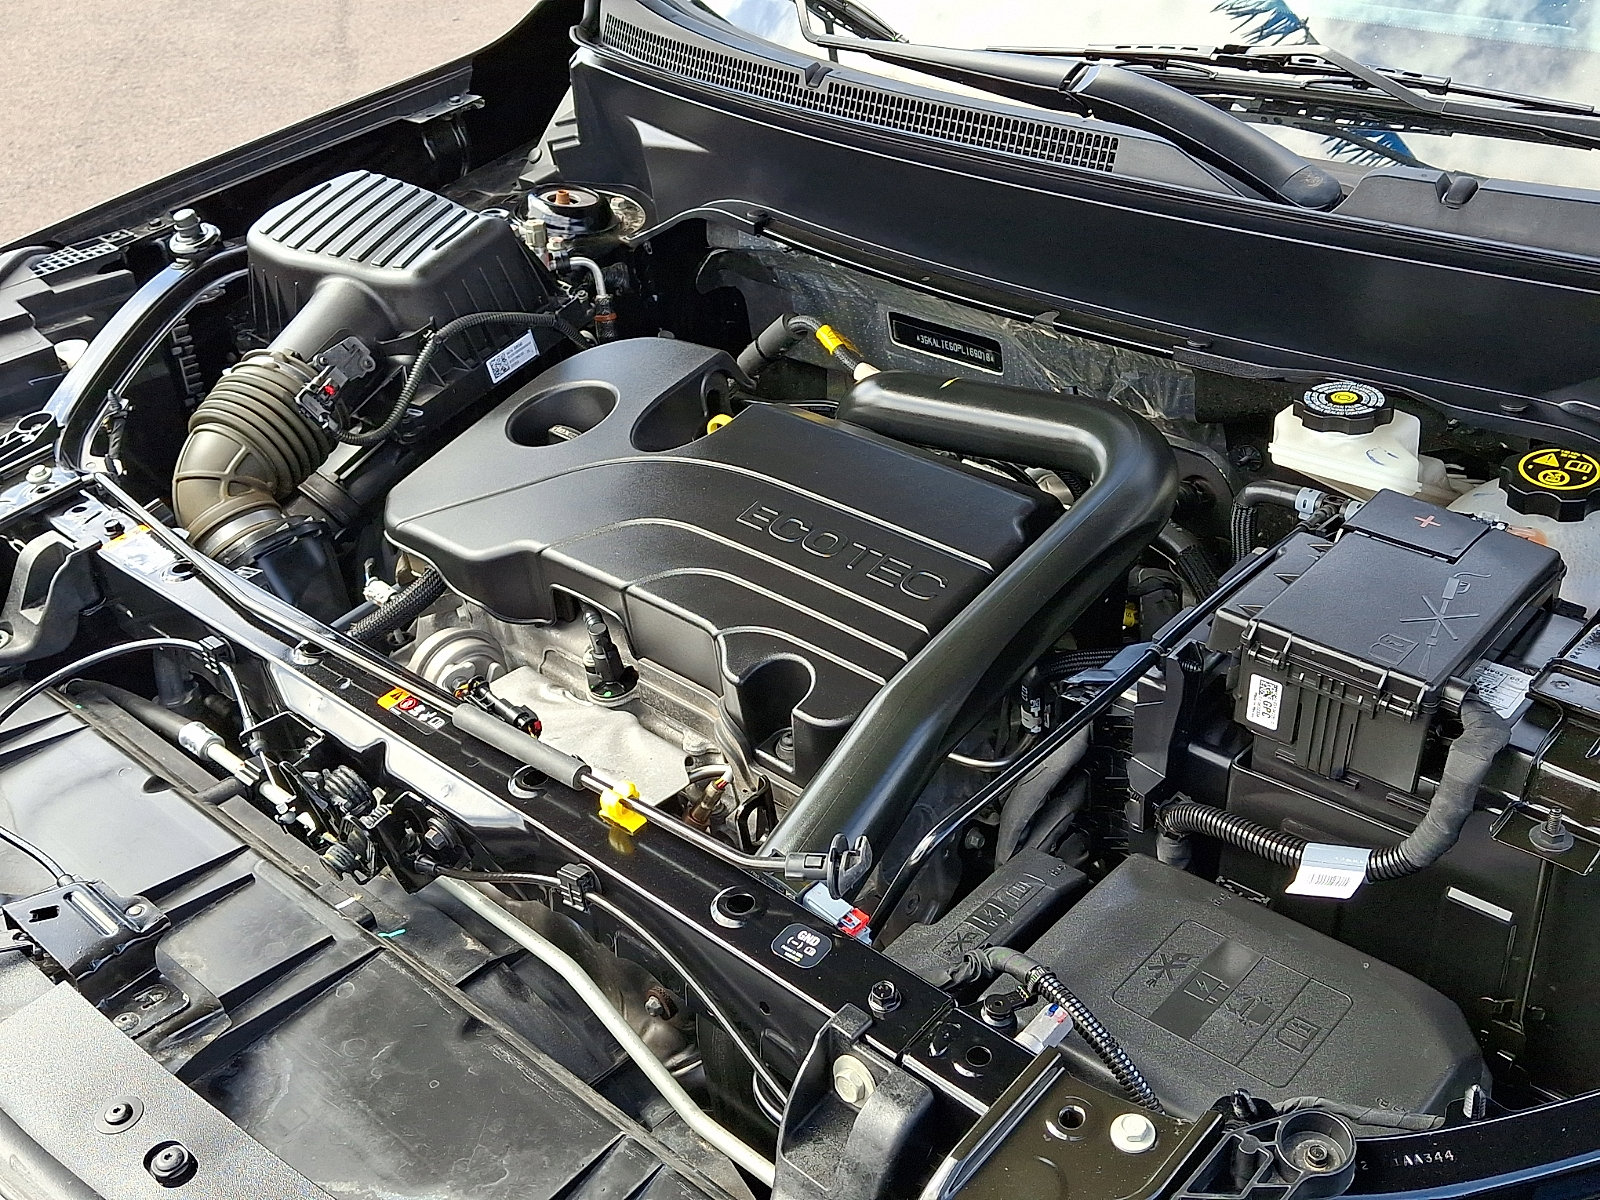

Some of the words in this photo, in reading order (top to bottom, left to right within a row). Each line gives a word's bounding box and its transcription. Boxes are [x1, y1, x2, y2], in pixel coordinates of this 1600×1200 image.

[736, 500, 949, 601] ECOTEC
[1262, 700, 1272, 718] GPC
[797, 930, 821, 947] GND
